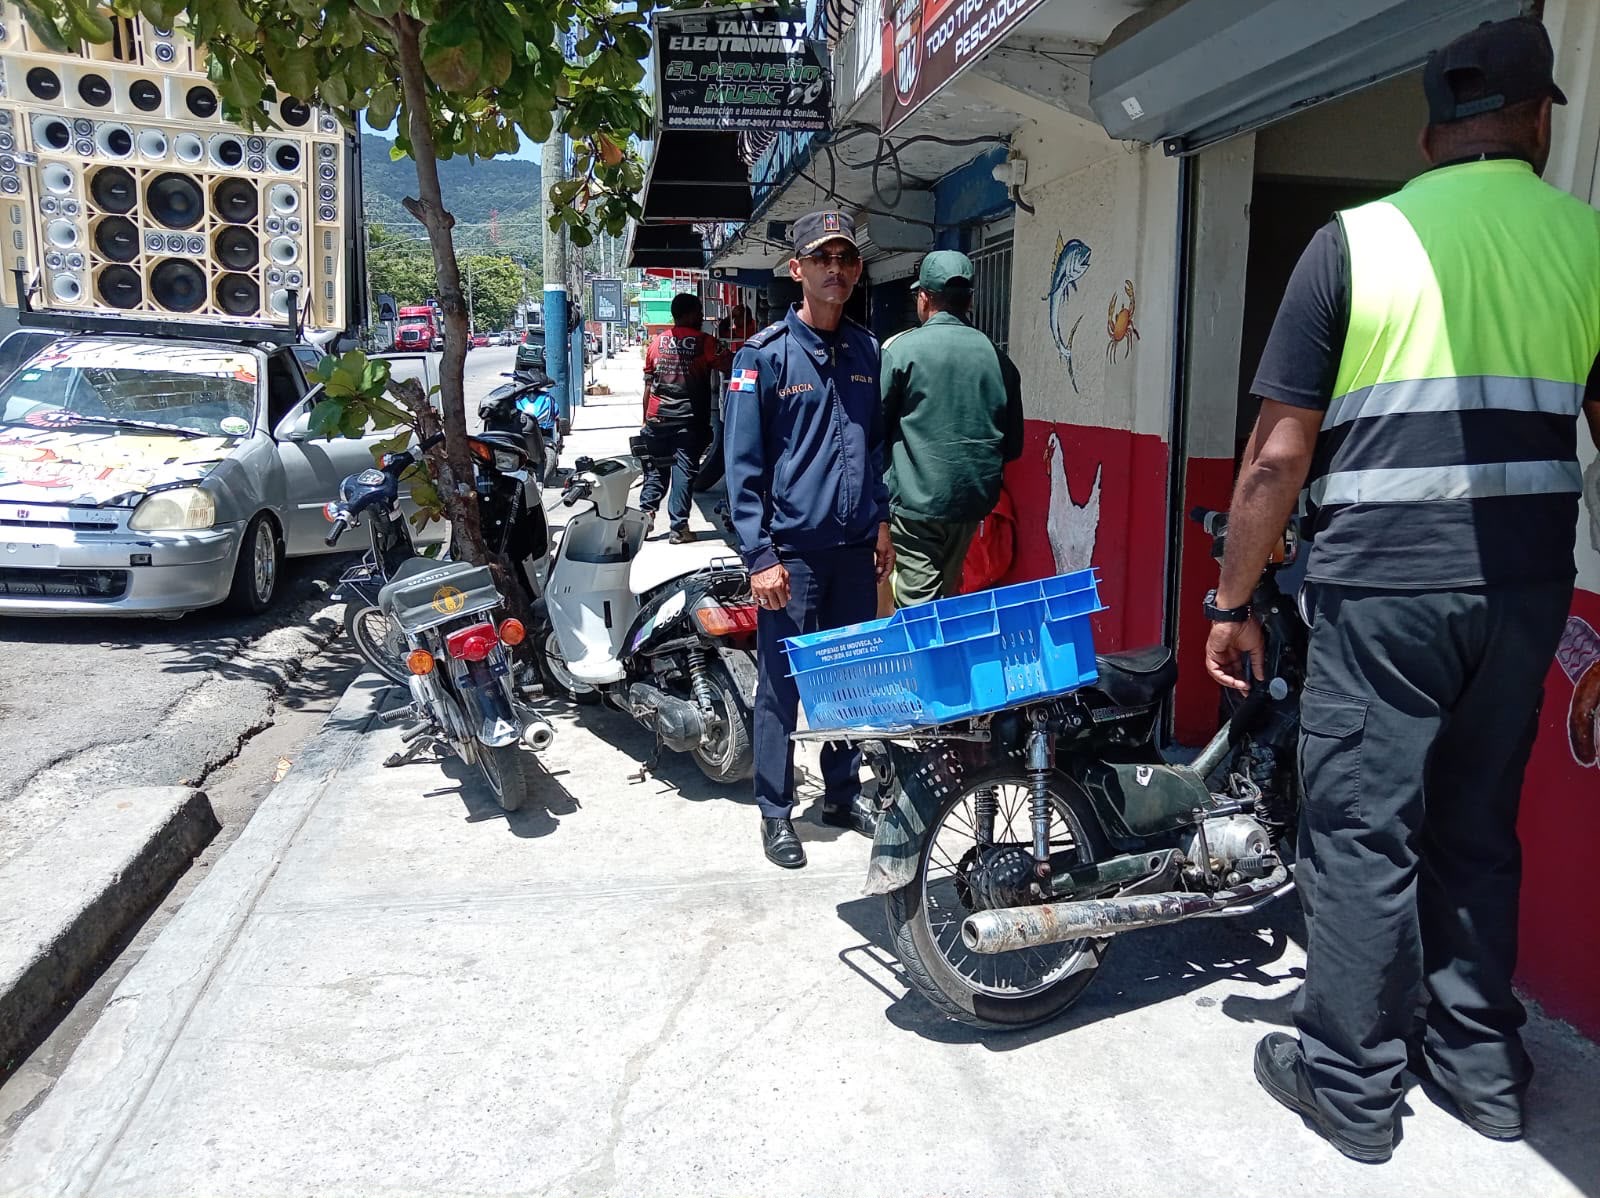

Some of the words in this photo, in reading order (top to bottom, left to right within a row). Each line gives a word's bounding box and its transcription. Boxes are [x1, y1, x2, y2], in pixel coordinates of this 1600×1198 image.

[716, 20, 789, 36] TALLER
[792, 22, 807, 36] Y
[926, 14, 955, 59] TODO
[665, 60, 697, 82] EL
[704, 84, 784, 104] MUSIC
[782, 108, 792, 117] de
[779, 383, 814, 397] GARCIA
